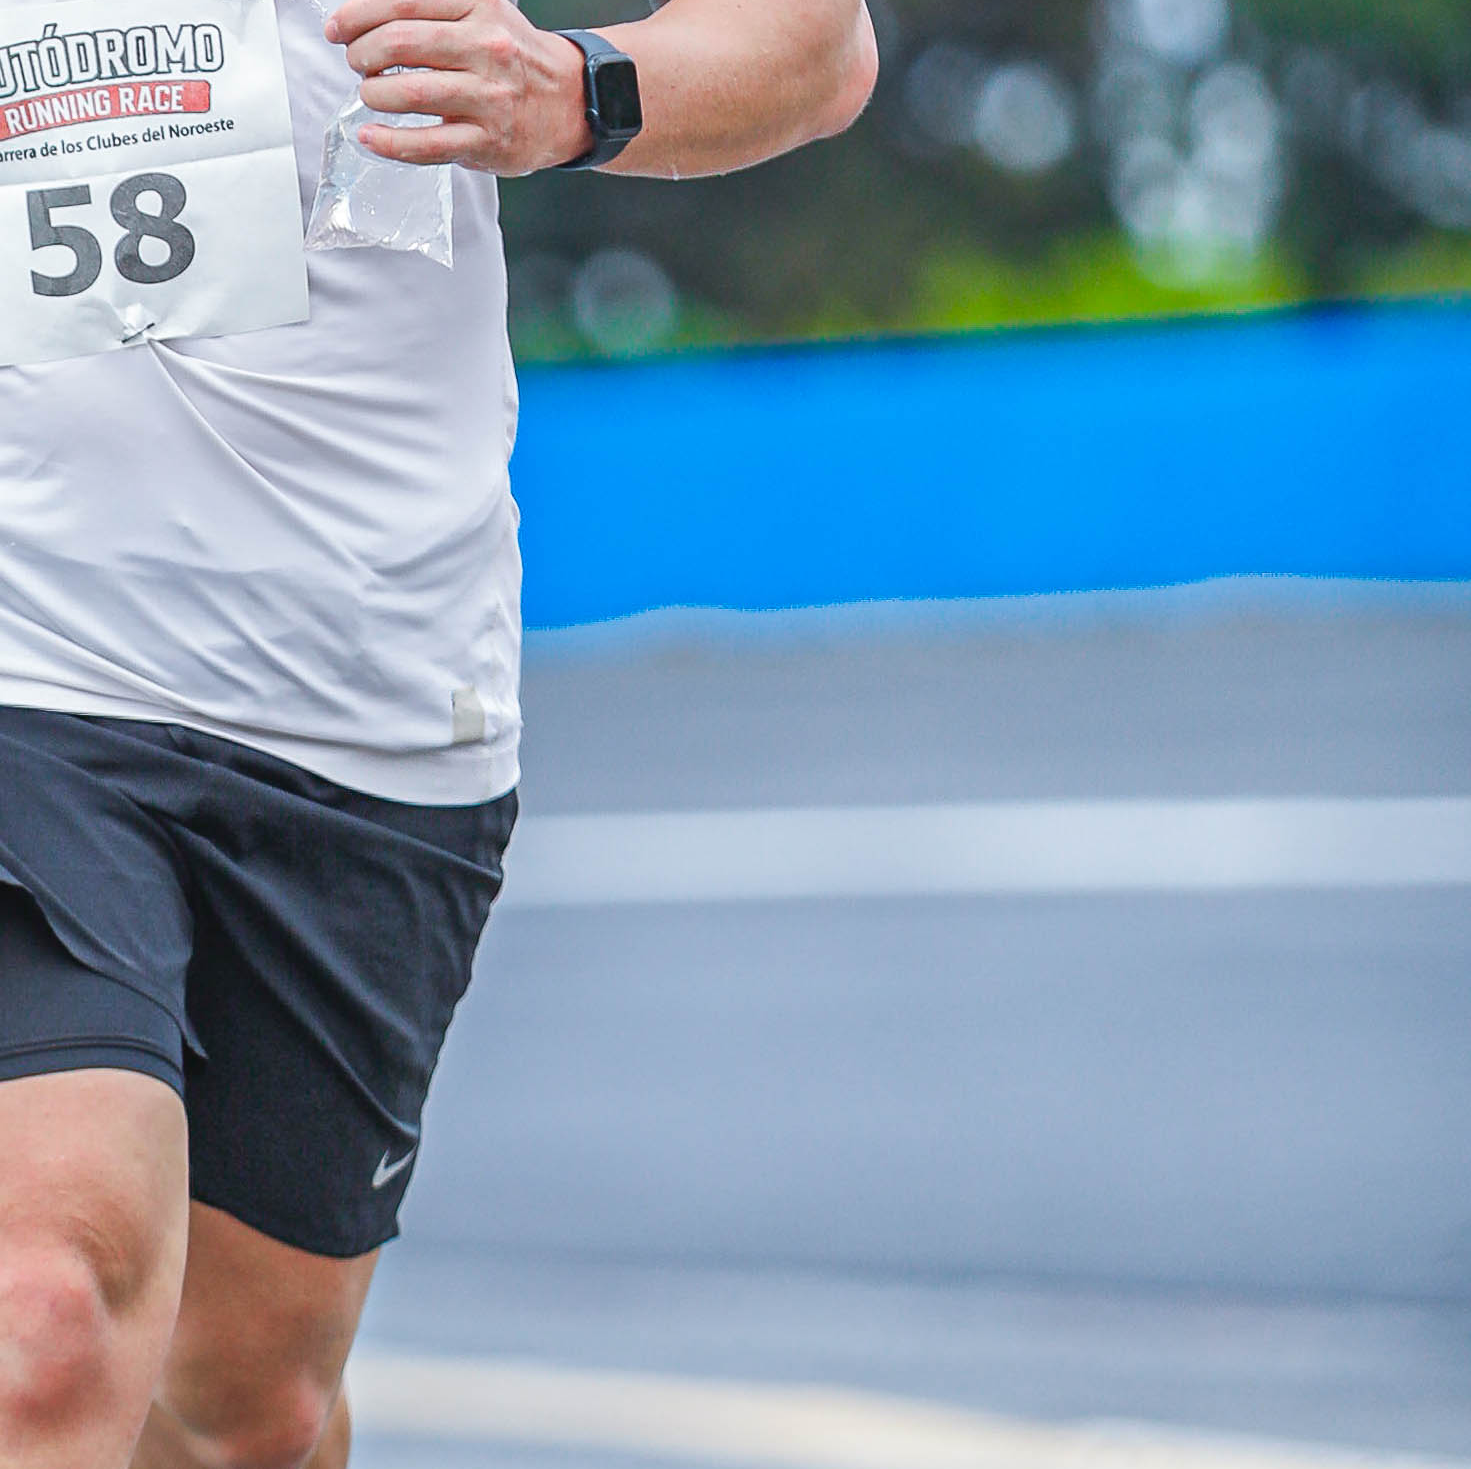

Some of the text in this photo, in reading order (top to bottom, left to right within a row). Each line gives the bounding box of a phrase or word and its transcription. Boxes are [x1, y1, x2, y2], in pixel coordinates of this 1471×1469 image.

[4, 85, 185, 135] RUNNING RACE
[40, 142, 58, 157] de
[61, 138, 83, 155] los
[86, 133, 138, 151] Clubes
[142, 125, 165, 143] del
[169, 118, 235, 138] Noroeste
[26, 172, 196, 298] 58
